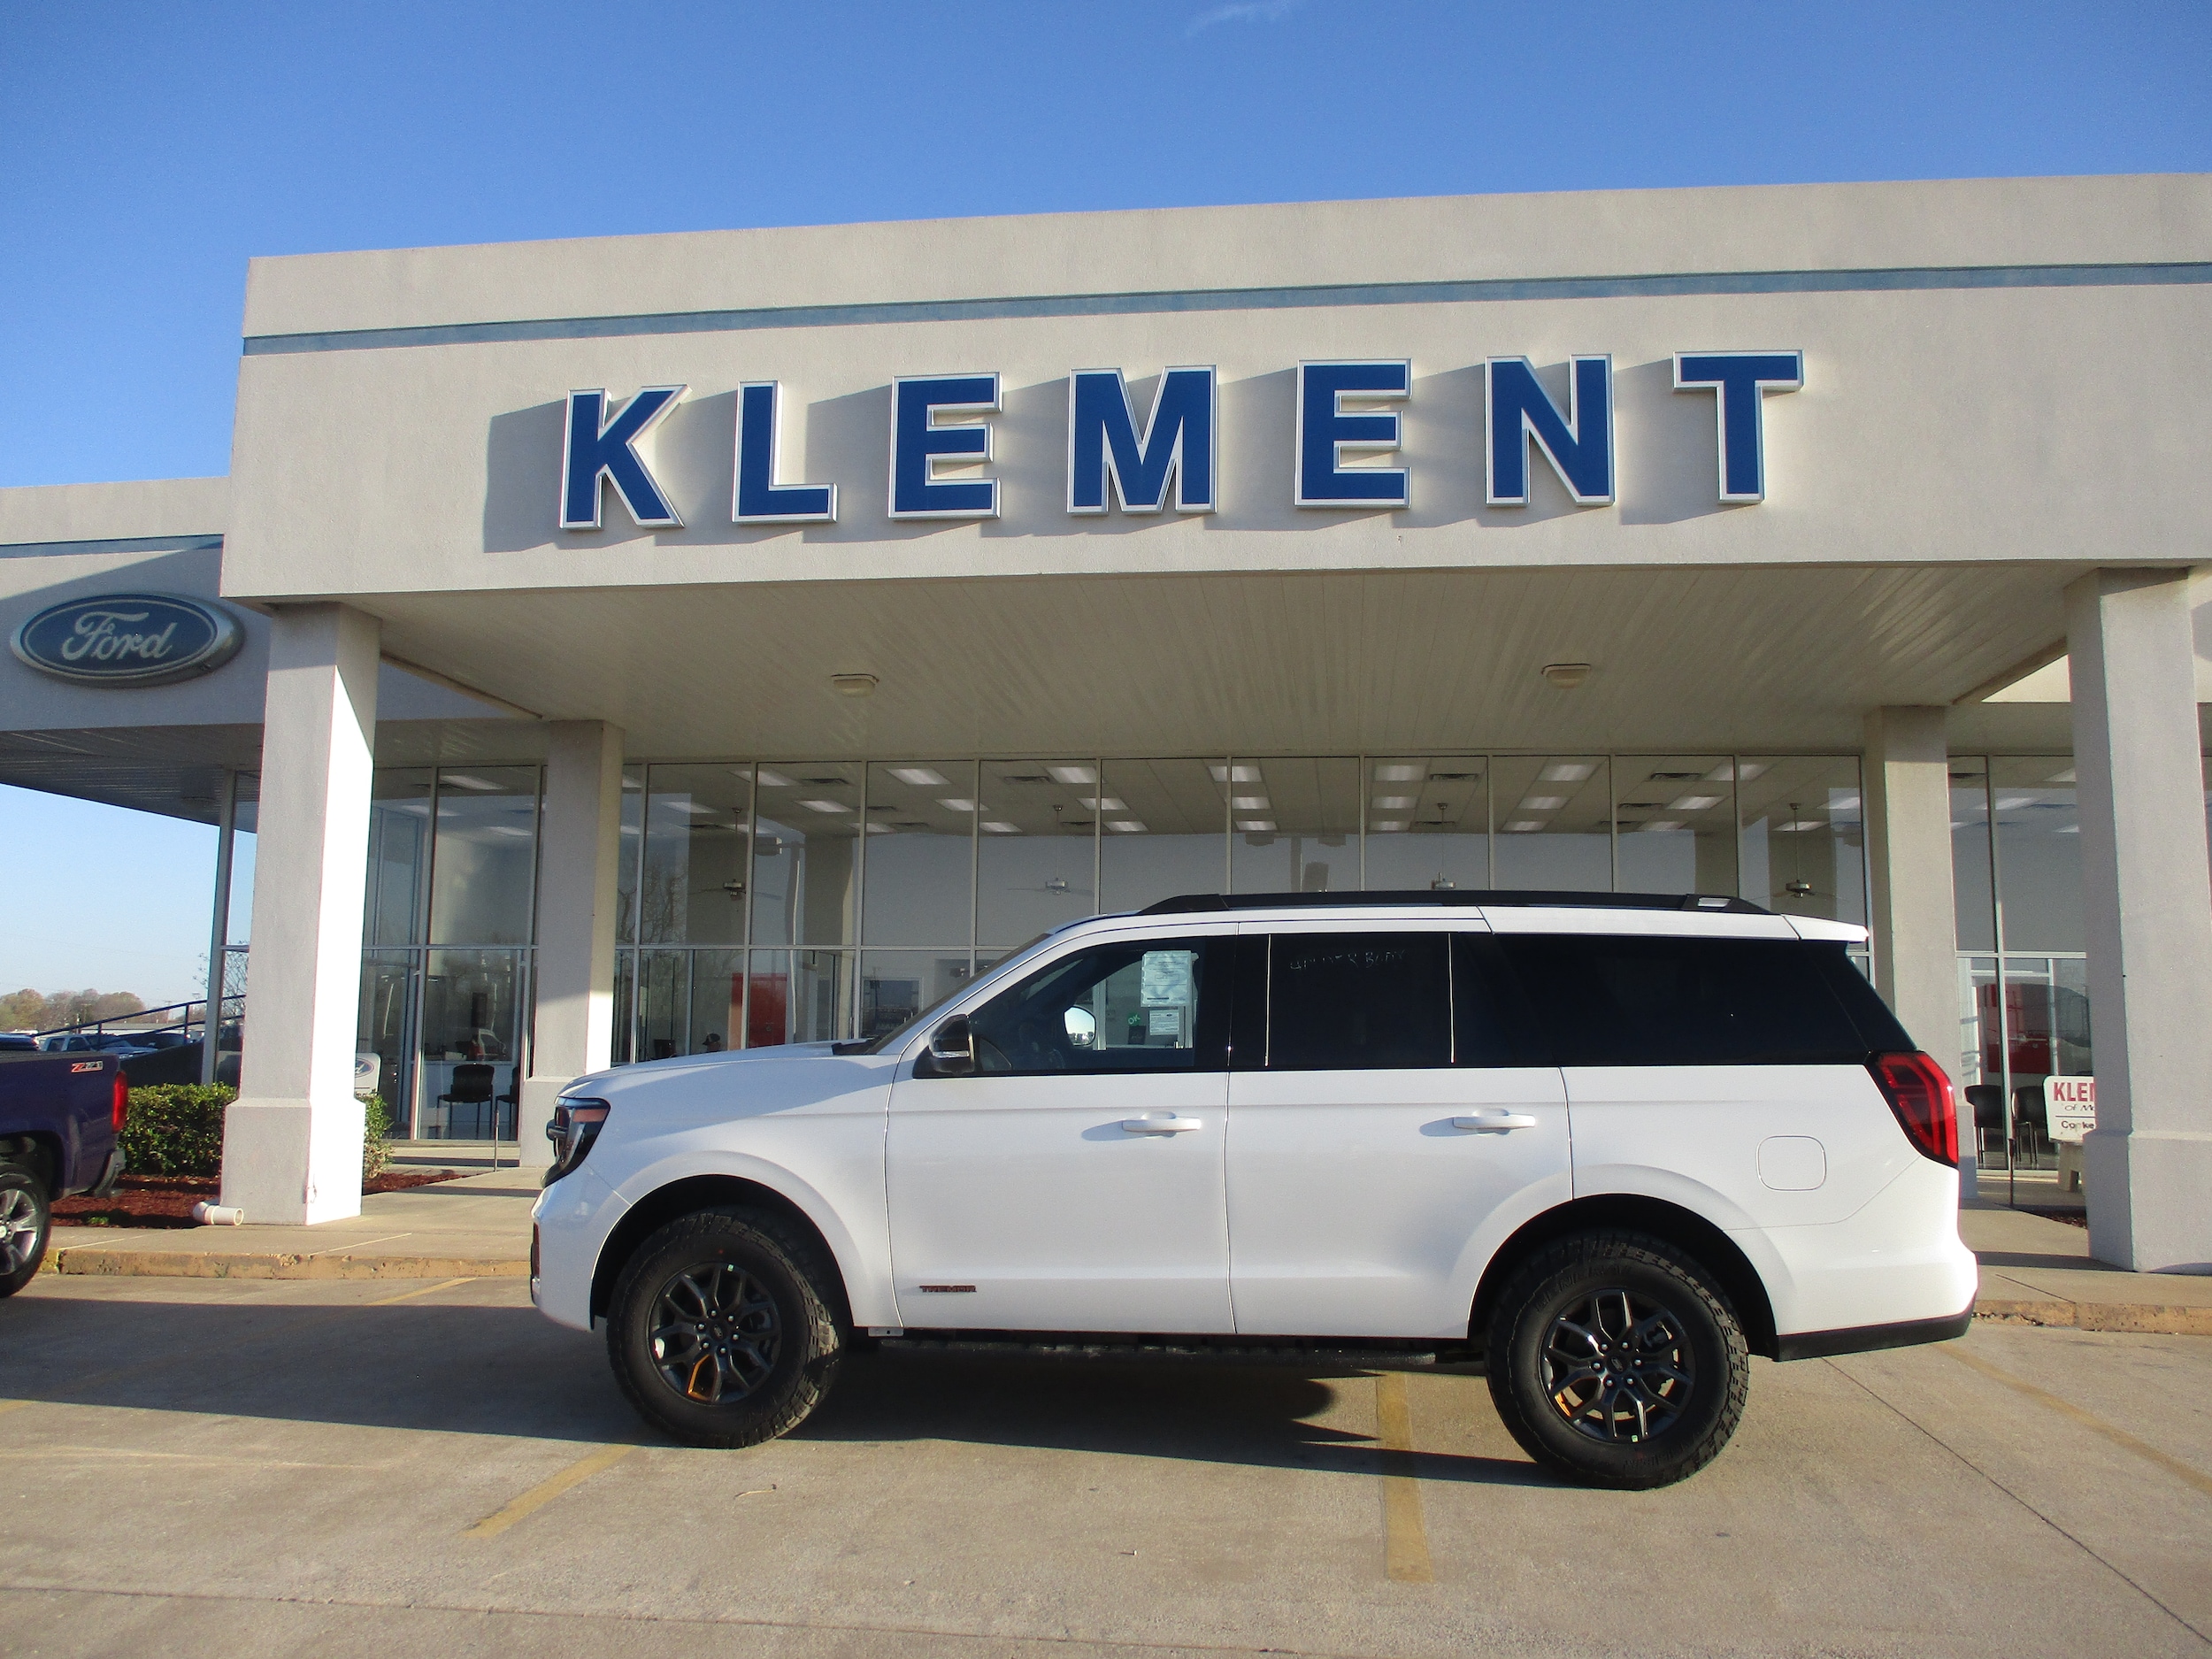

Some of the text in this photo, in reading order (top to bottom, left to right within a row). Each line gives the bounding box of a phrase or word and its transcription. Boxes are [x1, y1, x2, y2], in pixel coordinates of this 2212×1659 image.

[559, 349, 1804, 531] KLEMENT
[62, 612, 178, 660] Ford
[1128, 1015, 1141, 1025] OK
